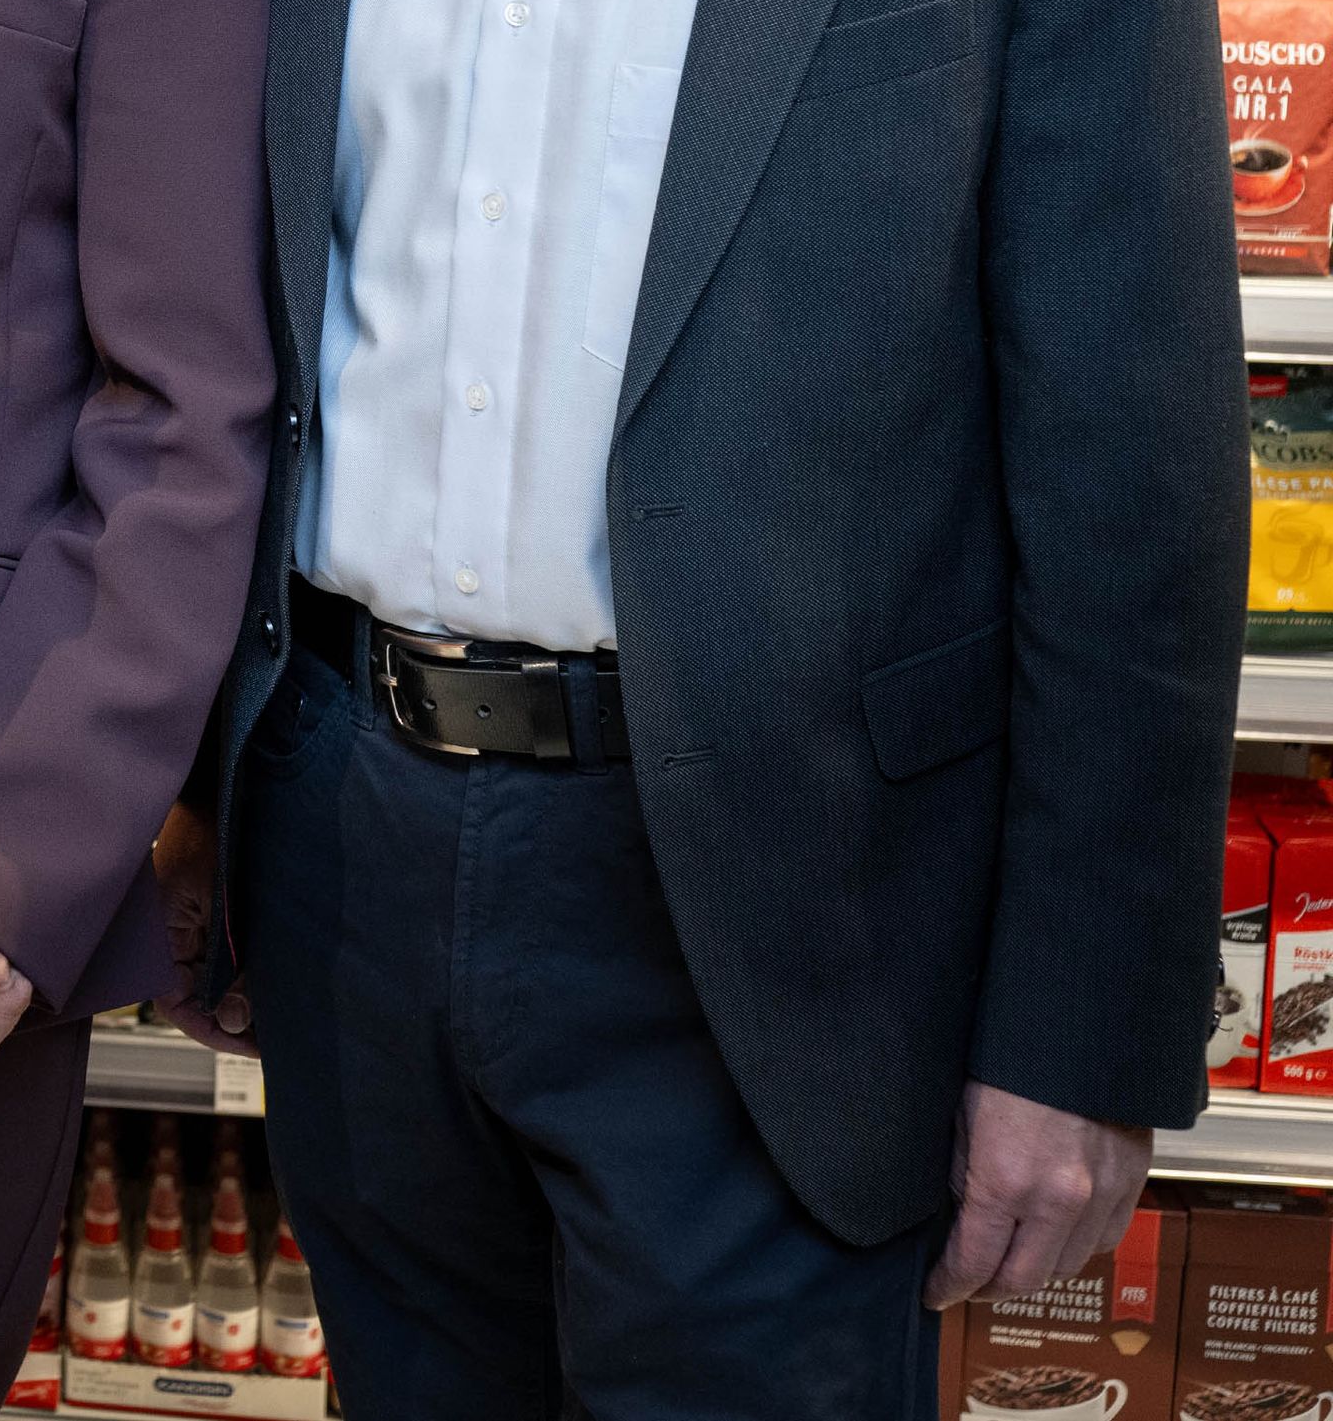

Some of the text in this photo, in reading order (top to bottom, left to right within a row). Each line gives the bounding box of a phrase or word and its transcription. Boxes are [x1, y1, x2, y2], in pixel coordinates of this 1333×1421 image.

[1222, 40, 1327, 67] DUSCHO
[1232, 74, 1293, 95] GALA
[1233, 92, 1290, 122] NR.1
[1255, 473, 1302, 491] LESE
[1208, 1284, 1266, 1303] FILTRES
[1282, 1288, 1319, 1306] CAFÉ
[992, 1301, 1103, 1323] COFFEE FILTERS
[1207, 1300, 1318, 1321] KOFFIEFILTERS
[1206, 1315, 1318, 1336] COFFEE FILTERS
